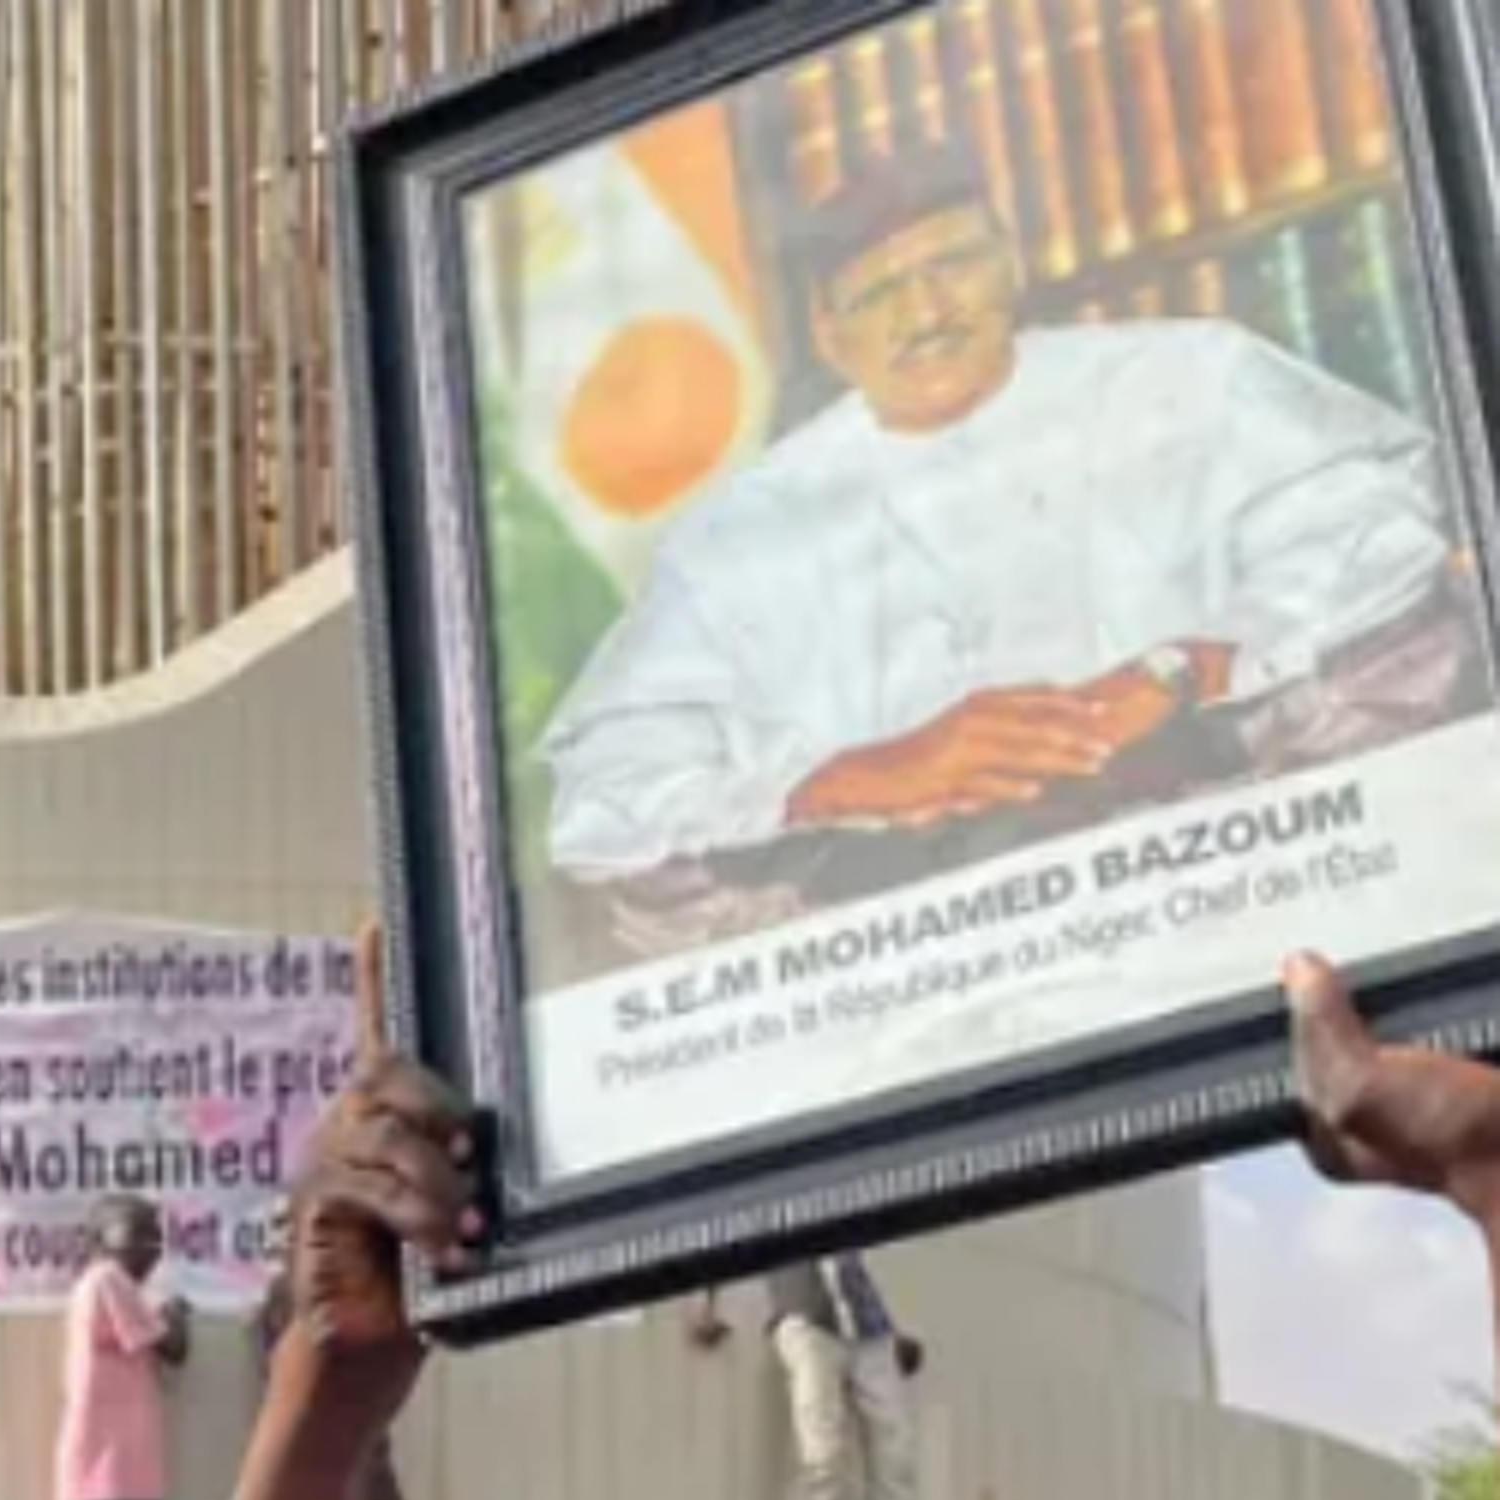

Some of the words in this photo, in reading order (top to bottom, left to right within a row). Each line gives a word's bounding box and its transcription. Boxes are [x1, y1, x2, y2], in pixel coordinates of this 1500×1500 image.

[777, 864, 1075, 986] MOHAMED
[1092, 780, 1364, 890] BAZOUM
[1012, 936, 1056, 973] du
[1164, 874, 1250, 926] Chef
[1253, 867, 1302, 905] de
[42, 940, 253, 1003] institutions
[264, 935, 310, 998] de
[49, 1038, 212, 1104] soutient
[223, 1036, 261, 1097] le
